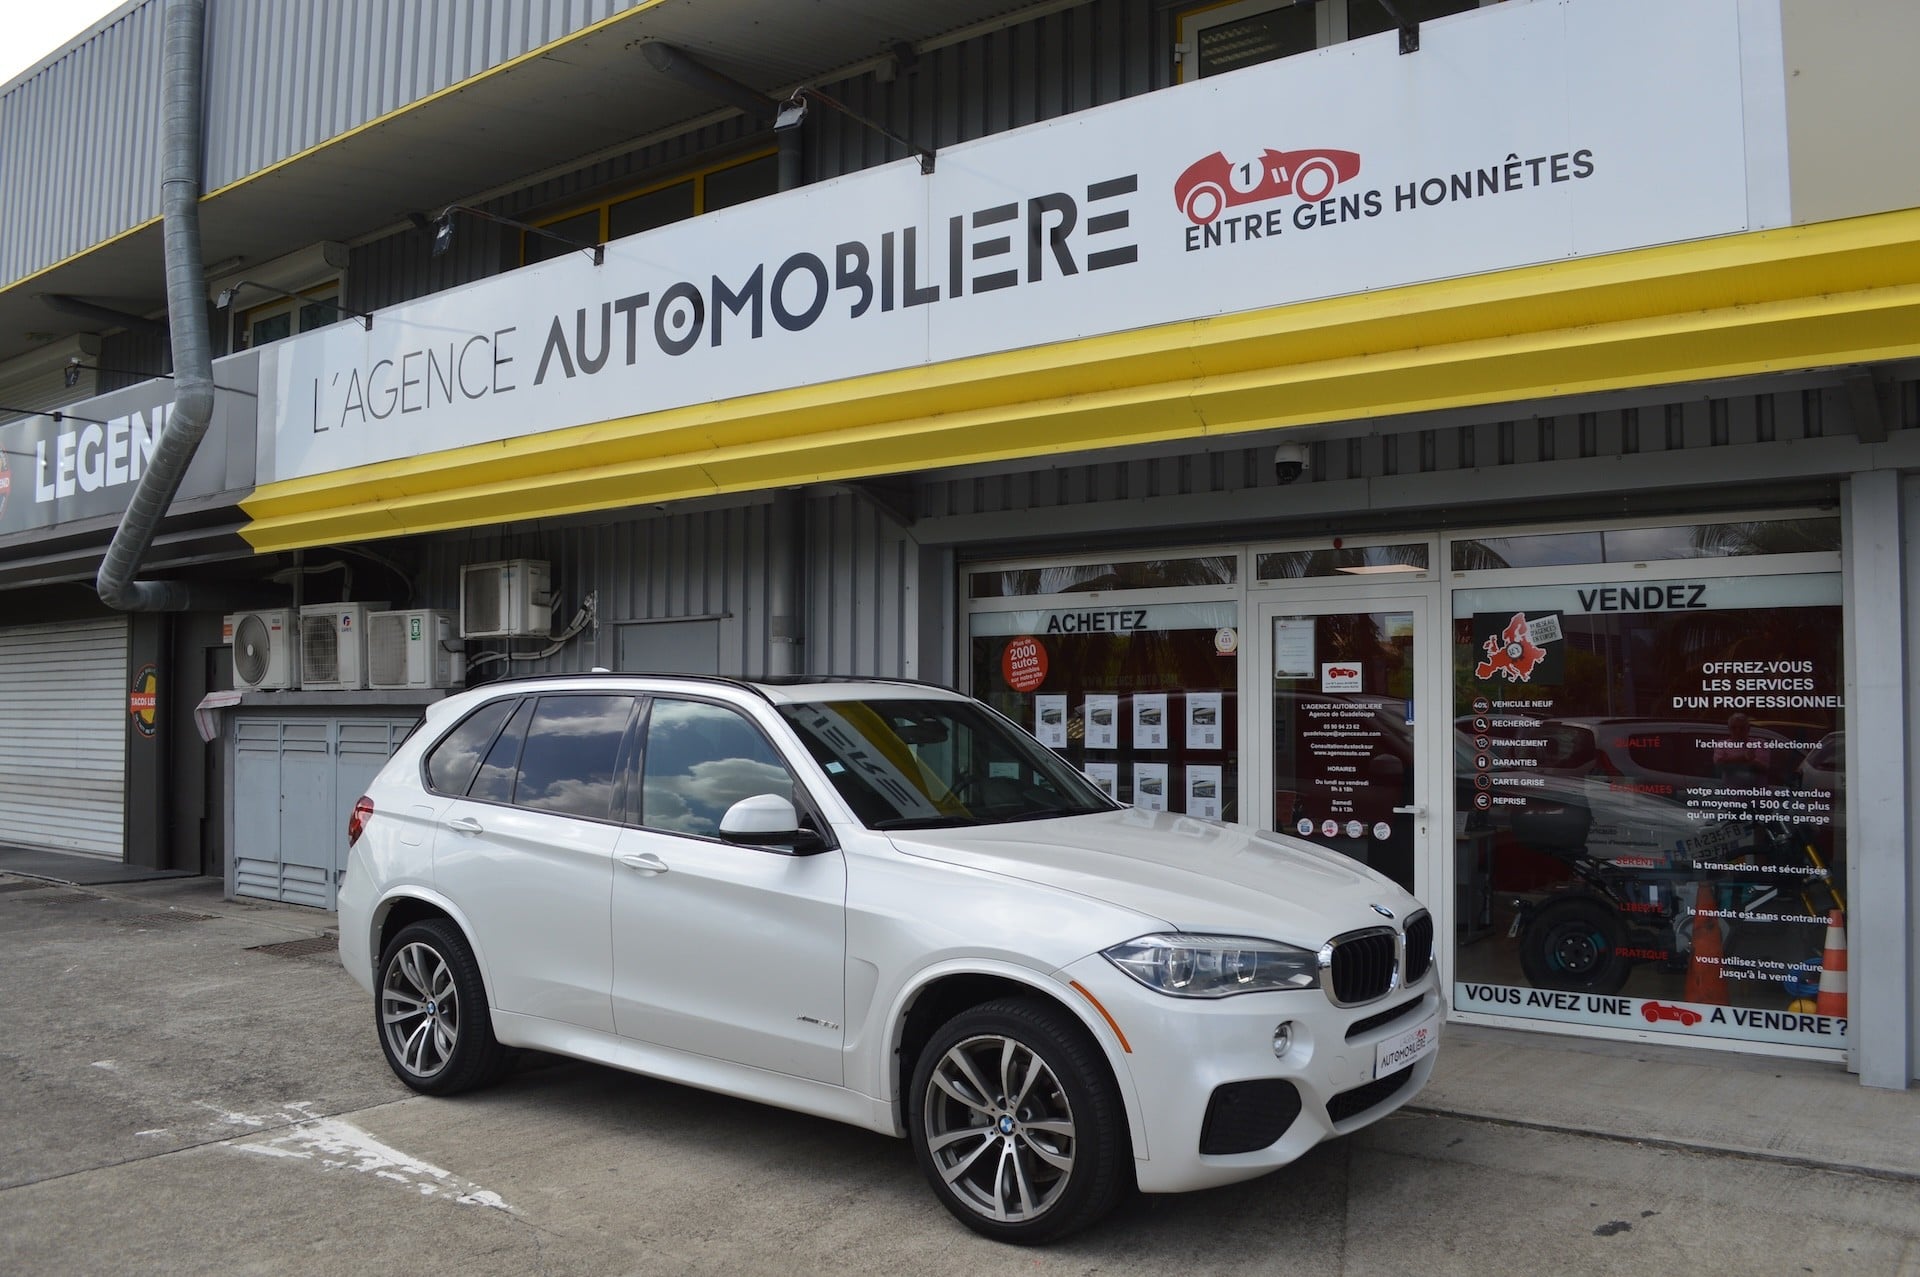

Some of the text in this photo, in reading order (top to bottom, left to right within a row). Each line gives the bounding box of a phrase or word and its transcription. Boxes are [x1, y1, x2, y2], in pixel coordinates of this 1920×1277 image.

[1185, 149, 1596, 252] ENTRE GENS HONNÊTES
[313, 173, 1139, 434] L'AGENCE AUTOMOBILIERE
[35, 402, 176, 504] LEGEN
[1577, 584, 1708, 612] VENDEZ
[1046, 609, 1148, 634] ACHETEZ
[1010, 644, 1037, 661] 2000
[1011, 657, 1039, 670] autos
[1702, 661, 1813, 675] OFFREZ-VOUS
[1011, 667, 1041, 677] disponibles
[1702, 678, 1814, 692] LES SERVICES
[131, 697, 147, 706] TACOS
[1491, 700, 1554, 708] VEHICULE NEUF
[1672, 695, 1846, 709] D'UN PROFESSIONNEL
[1308, 711, 1331, 719] Agence
[1340, 710, 1376, 718] Guadeloupe
[1491, 720, 1541, 728] RECHERCHE
[1492, 739, 1549, 747] FINANCEMENT
[1615, 736, 1661, 748] QUALITÉ
[1695, 738, 1823, 750] l'acheteur est sélectionné
[1492, 758, 1538, 767] GARANTIES
[1492, 778, 1546, 787] CARTE GRISE
[1686, 787, 1832, 799] votre automobile est vendue
[1492, 797, 1527, 805] REPRISE
[1686, 799, 1831, 813] en moyenne 1 500 € de plus
[1686, 810, 1831, 825] qu'un prix de reprise garage
[1692, 859, 1829, 876] la transaction est sécurisée
[1686, 906, 1834, 925] le mandat est sans contrainte
[1615, 947, 1670, 960] PRATIQUE
[1695, 955, 1824, 973] vous utilisez votre voiture
[1719, 968, 1798, 983] jusqu'à la vente
[1464, 983, 1522, 1005] VOUS
[1526, 990, 1582, 1012] AVEZ
[1587, 996, 1633, 1017] UNE
[1710, 1007, 1727, 1025] A
[1732, 1008, 1832, 1035] VENDRE
